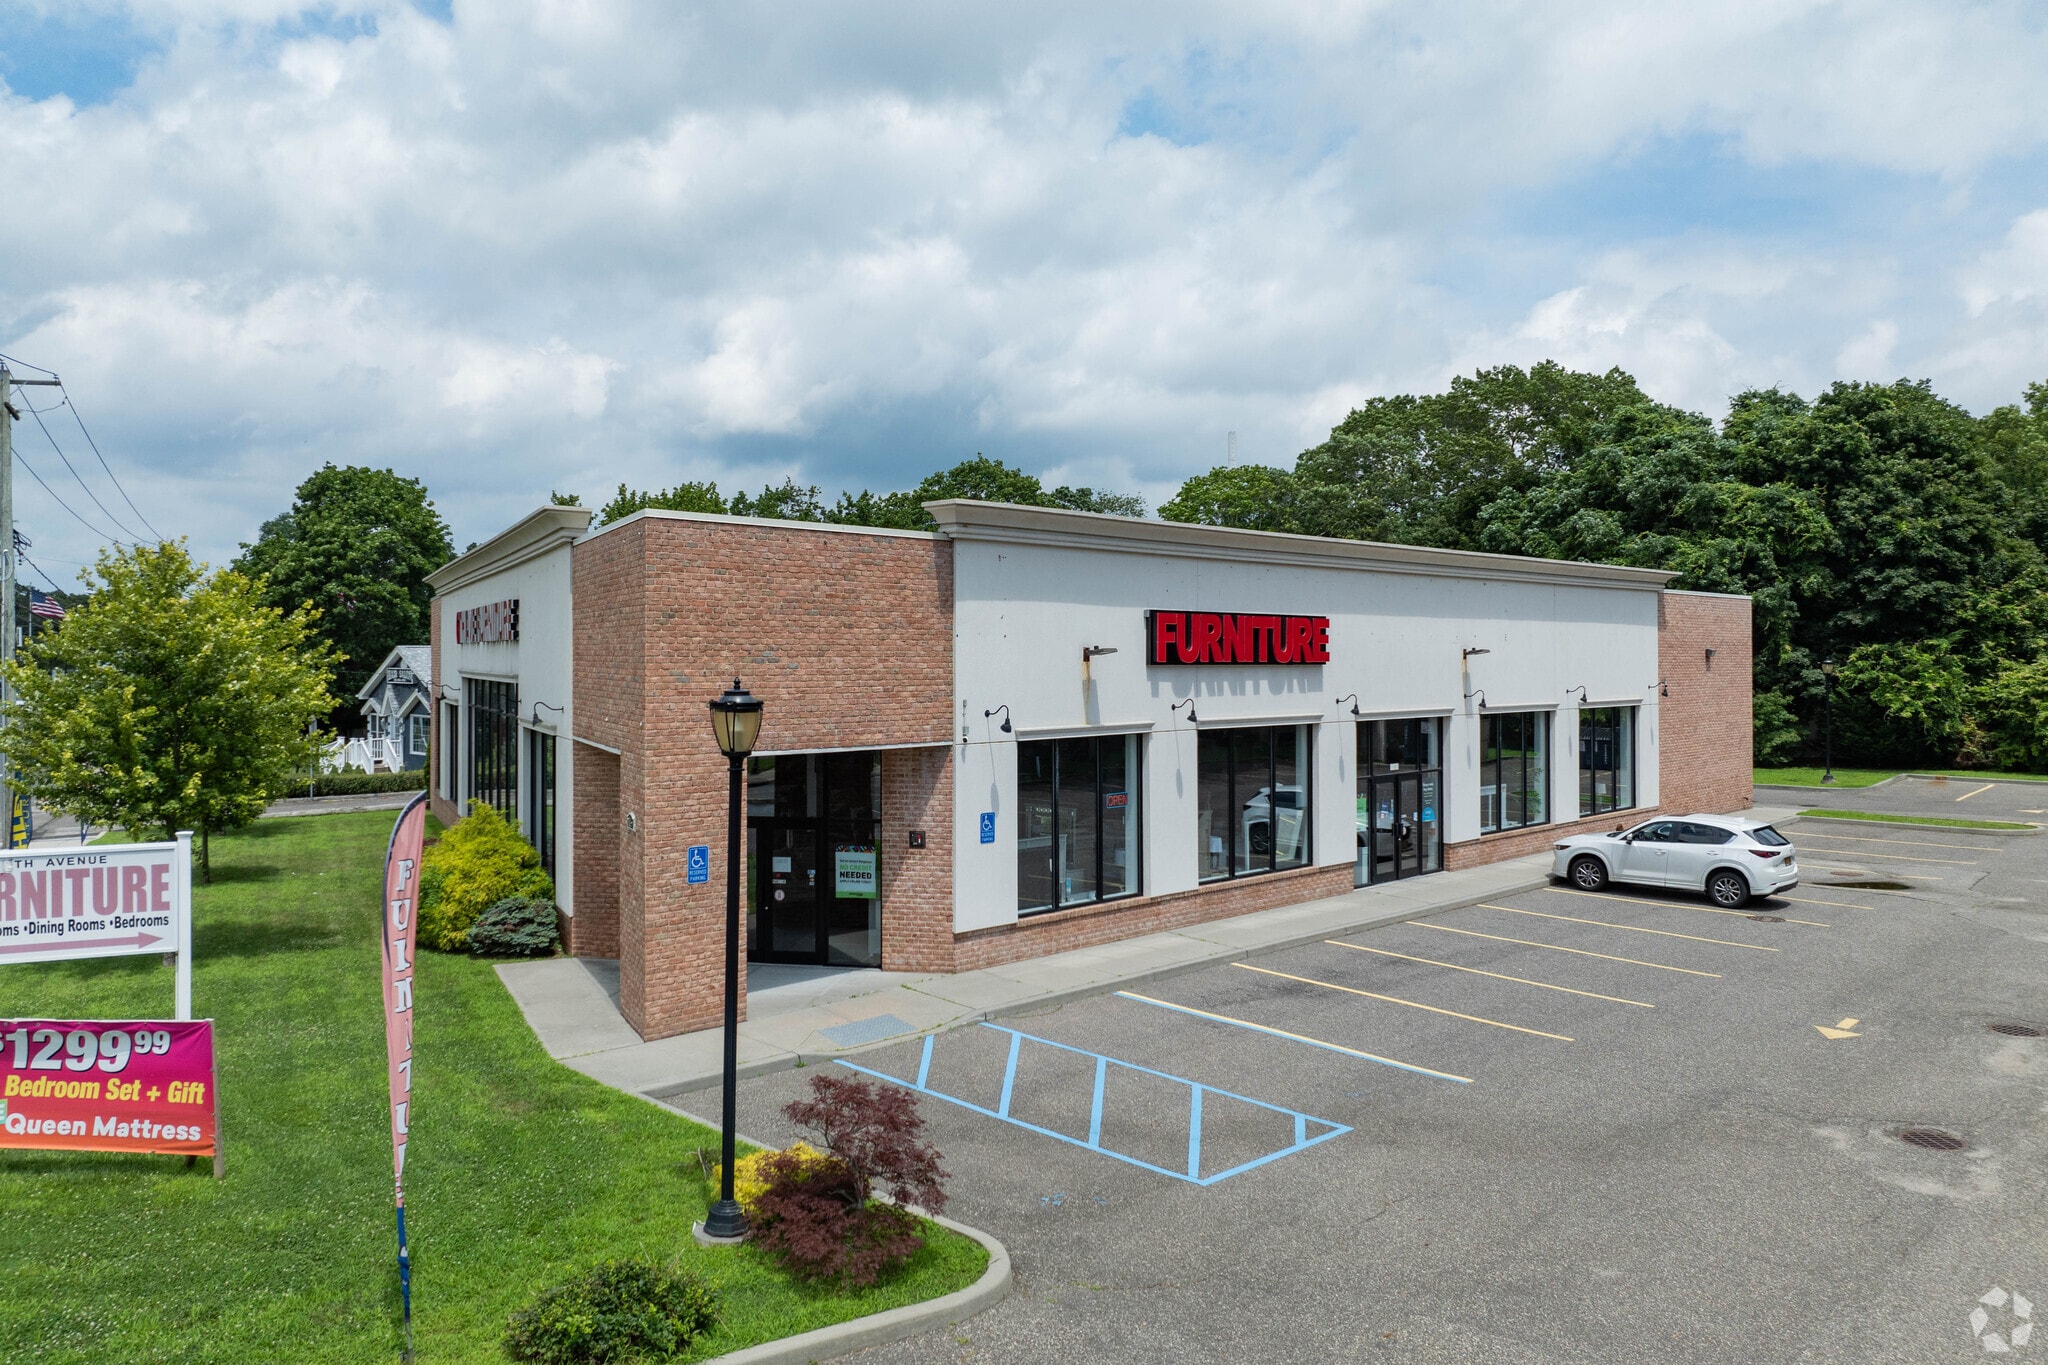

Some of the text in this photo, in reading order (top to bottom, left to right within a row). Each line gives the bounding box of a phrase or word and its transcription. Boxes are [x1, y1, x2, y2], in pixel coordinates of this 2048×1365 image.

[1156, 612, 1330, 663] FURNITURE
[1108, 795, 1128, 806] OPEN
[46, 856, 107, 867] AVENUE
[840, 871, 872, 879] NEEDED
[68, 918, 106, 932] Rooms
[5, 1075, 100, 1099] Bedroom
[106, 1078, 141, 1101] Set
[168, 1081, 205, 1105] Gift
[5, 1112, 87, 1135] Queen
[93, 1115, 201, 1141] Mattress
